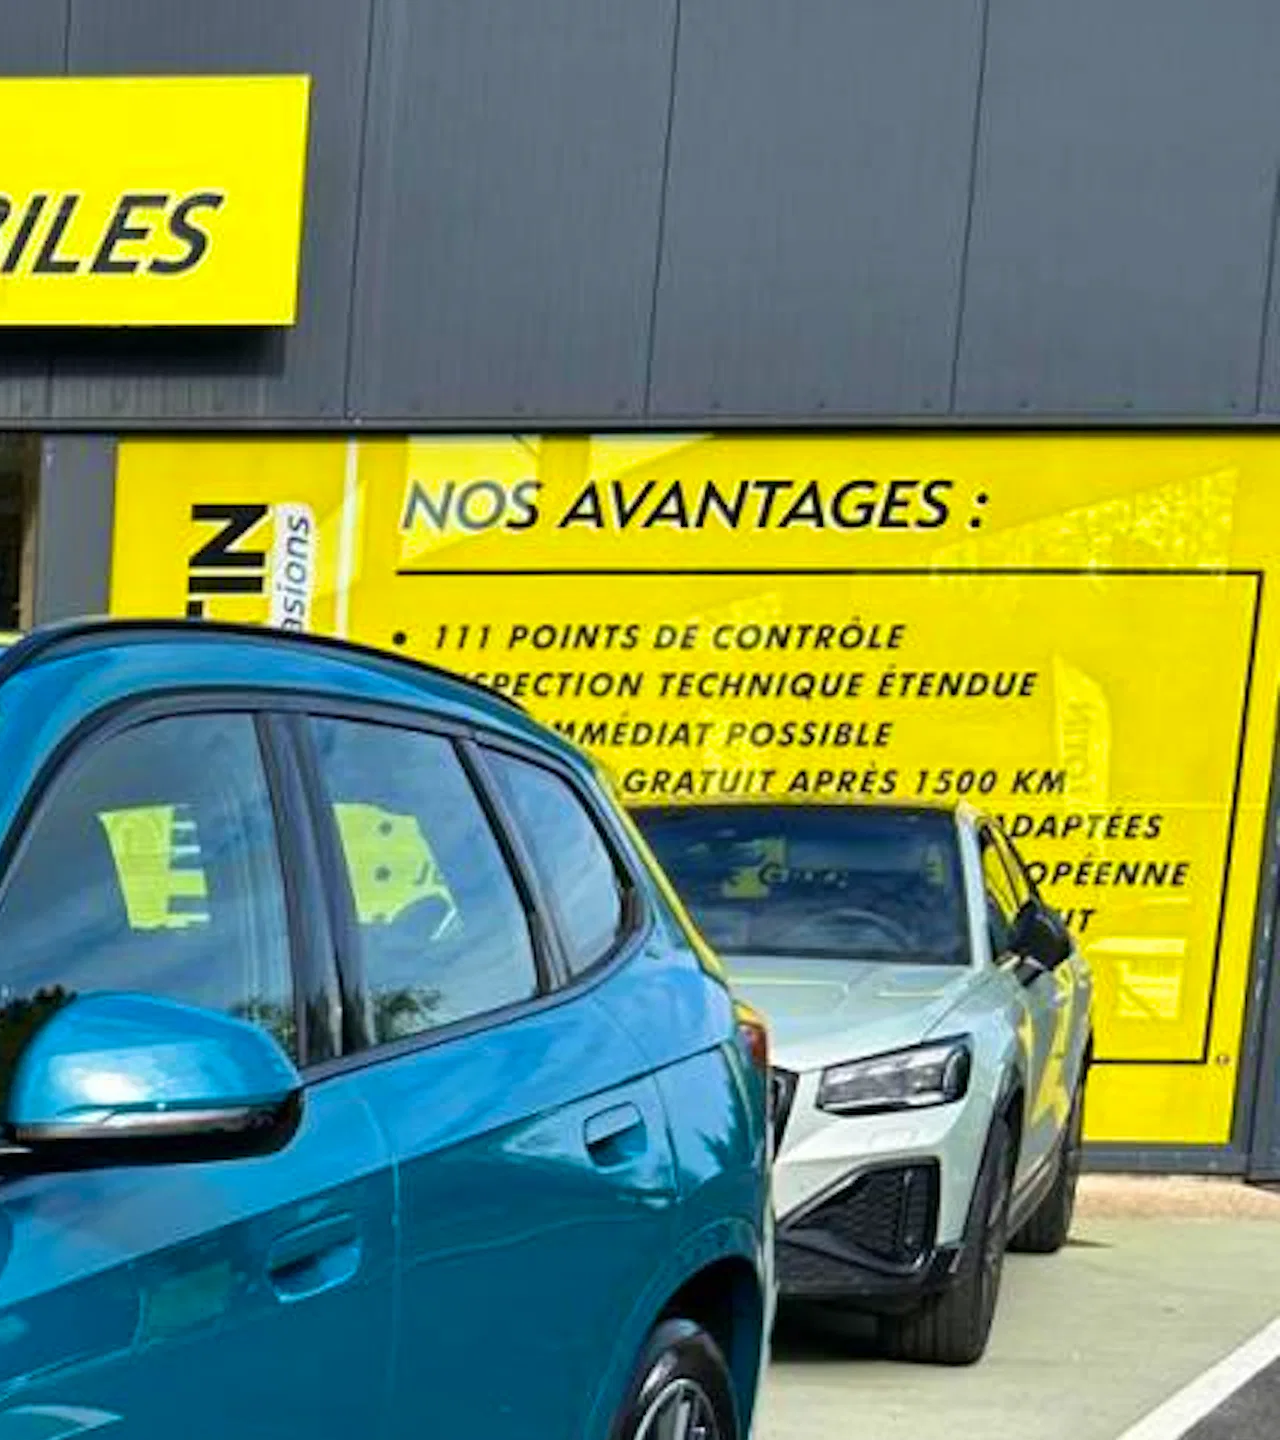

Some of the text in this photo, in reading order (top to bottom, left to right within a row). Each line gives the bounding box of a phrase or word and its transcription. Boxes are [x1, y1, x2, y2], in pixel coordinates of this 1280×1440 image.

[403, 479, 543, 529] NOS
[557, 480, 954, 529] AVANTAGES
[435, 615, 907, 650] 111 POINTS DE CONTRÔLE
[658, 671, 865, 700] TECHNIQUE
[877, 663, 1039, 698] ÉTENDUE
[726, 722, 894, 747] POSSIBLE
[623, 760, 1067, 795] GRATUIT APRÈS 1500 KM
